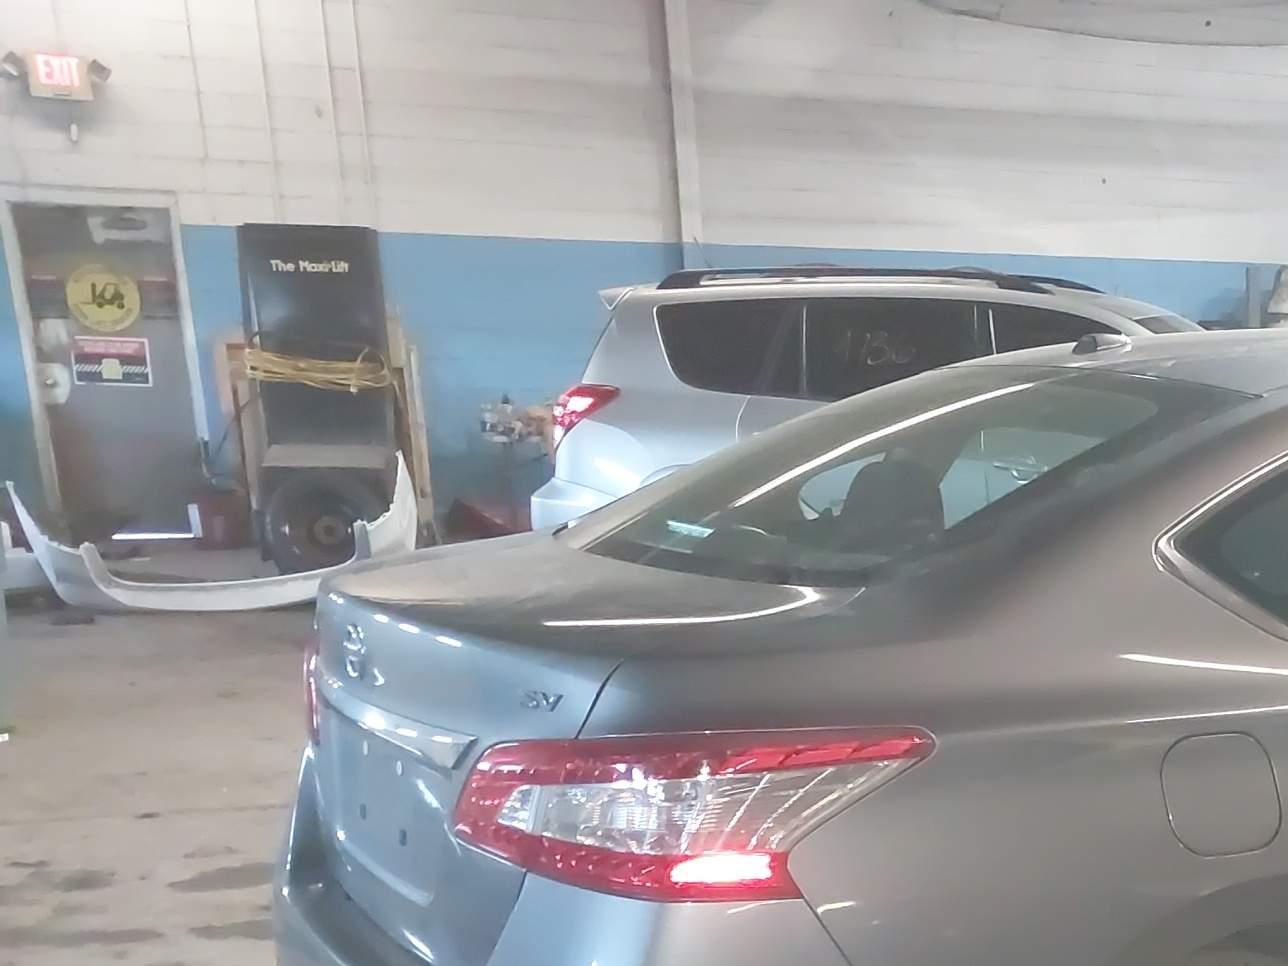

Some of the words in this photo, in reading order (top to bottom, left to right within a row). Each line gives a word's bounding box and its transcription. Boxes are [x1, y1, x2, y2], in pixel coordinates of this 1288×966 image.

[35, 53, 80, 87] EXIT
[269, 259, 296, 272] The
[519, 688, 564, 713] SV
